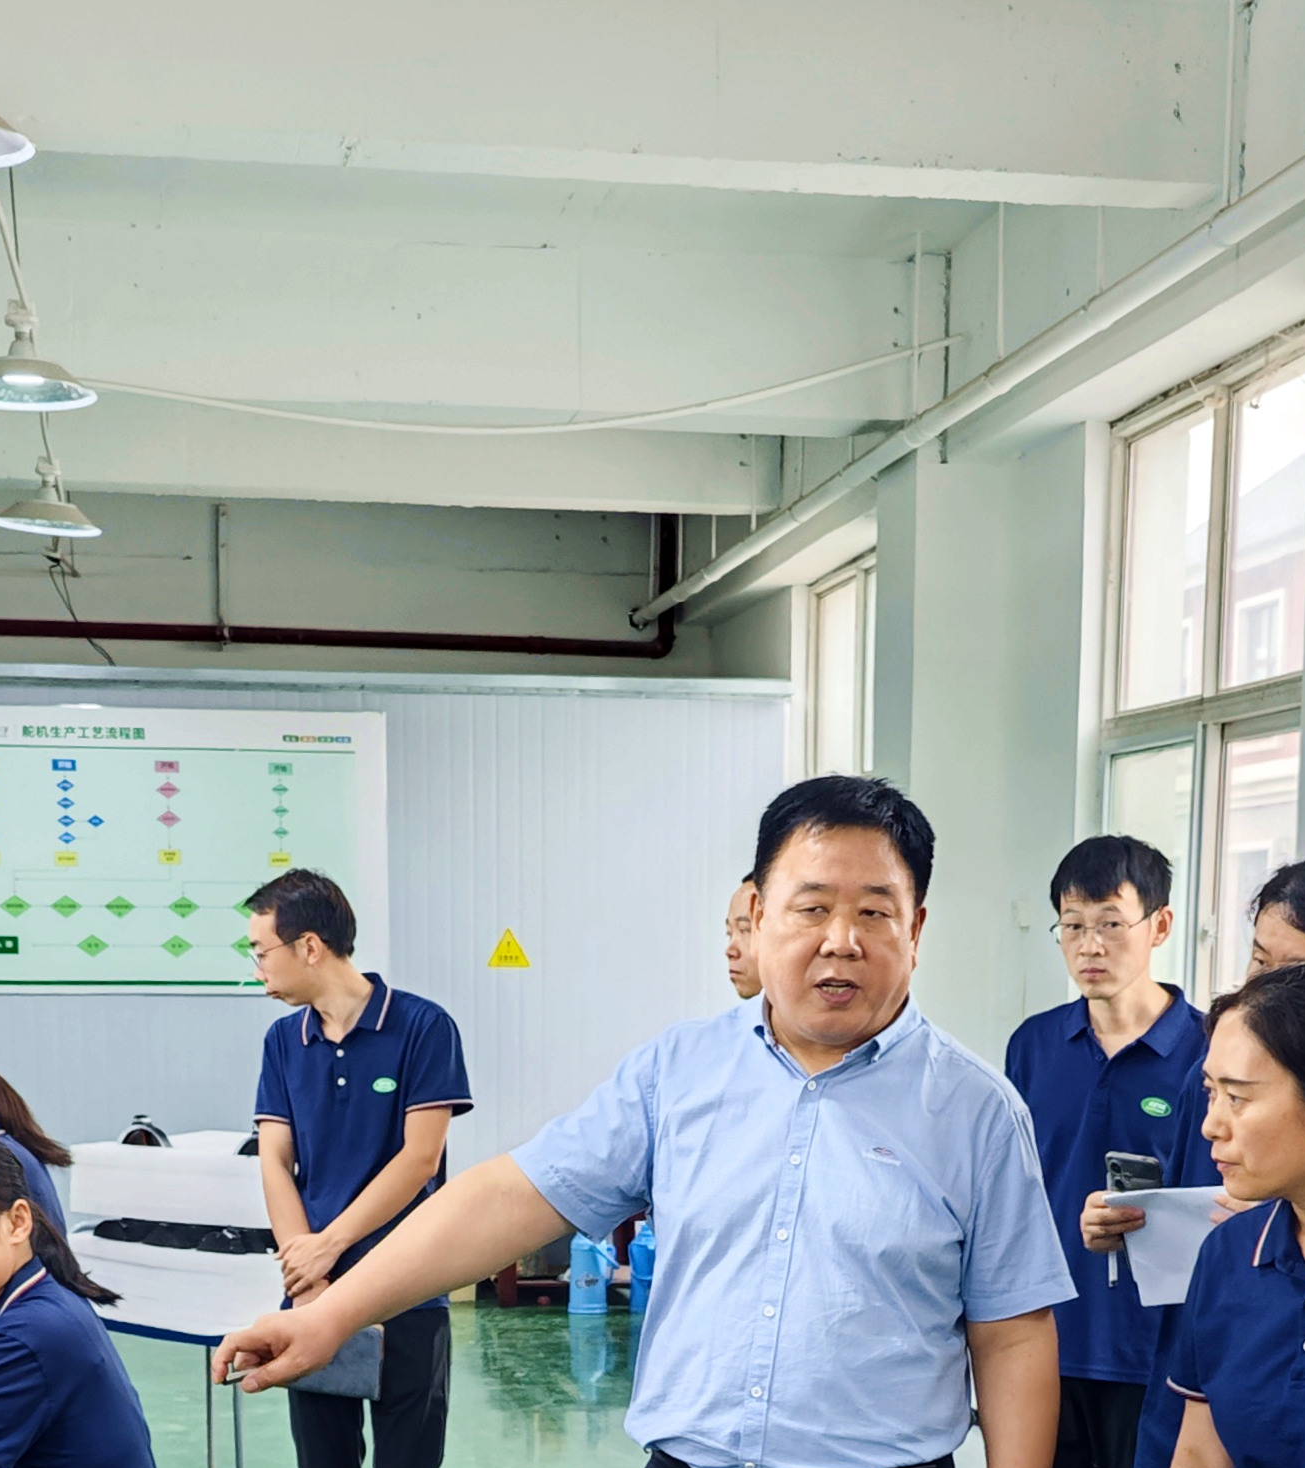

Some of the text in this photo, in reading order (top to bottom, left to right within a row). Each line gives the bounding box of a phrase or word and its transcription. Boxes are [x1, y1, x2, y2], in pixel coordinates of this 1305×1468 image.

[22, 724, 146, 740] 舵机生产工艺流程图
